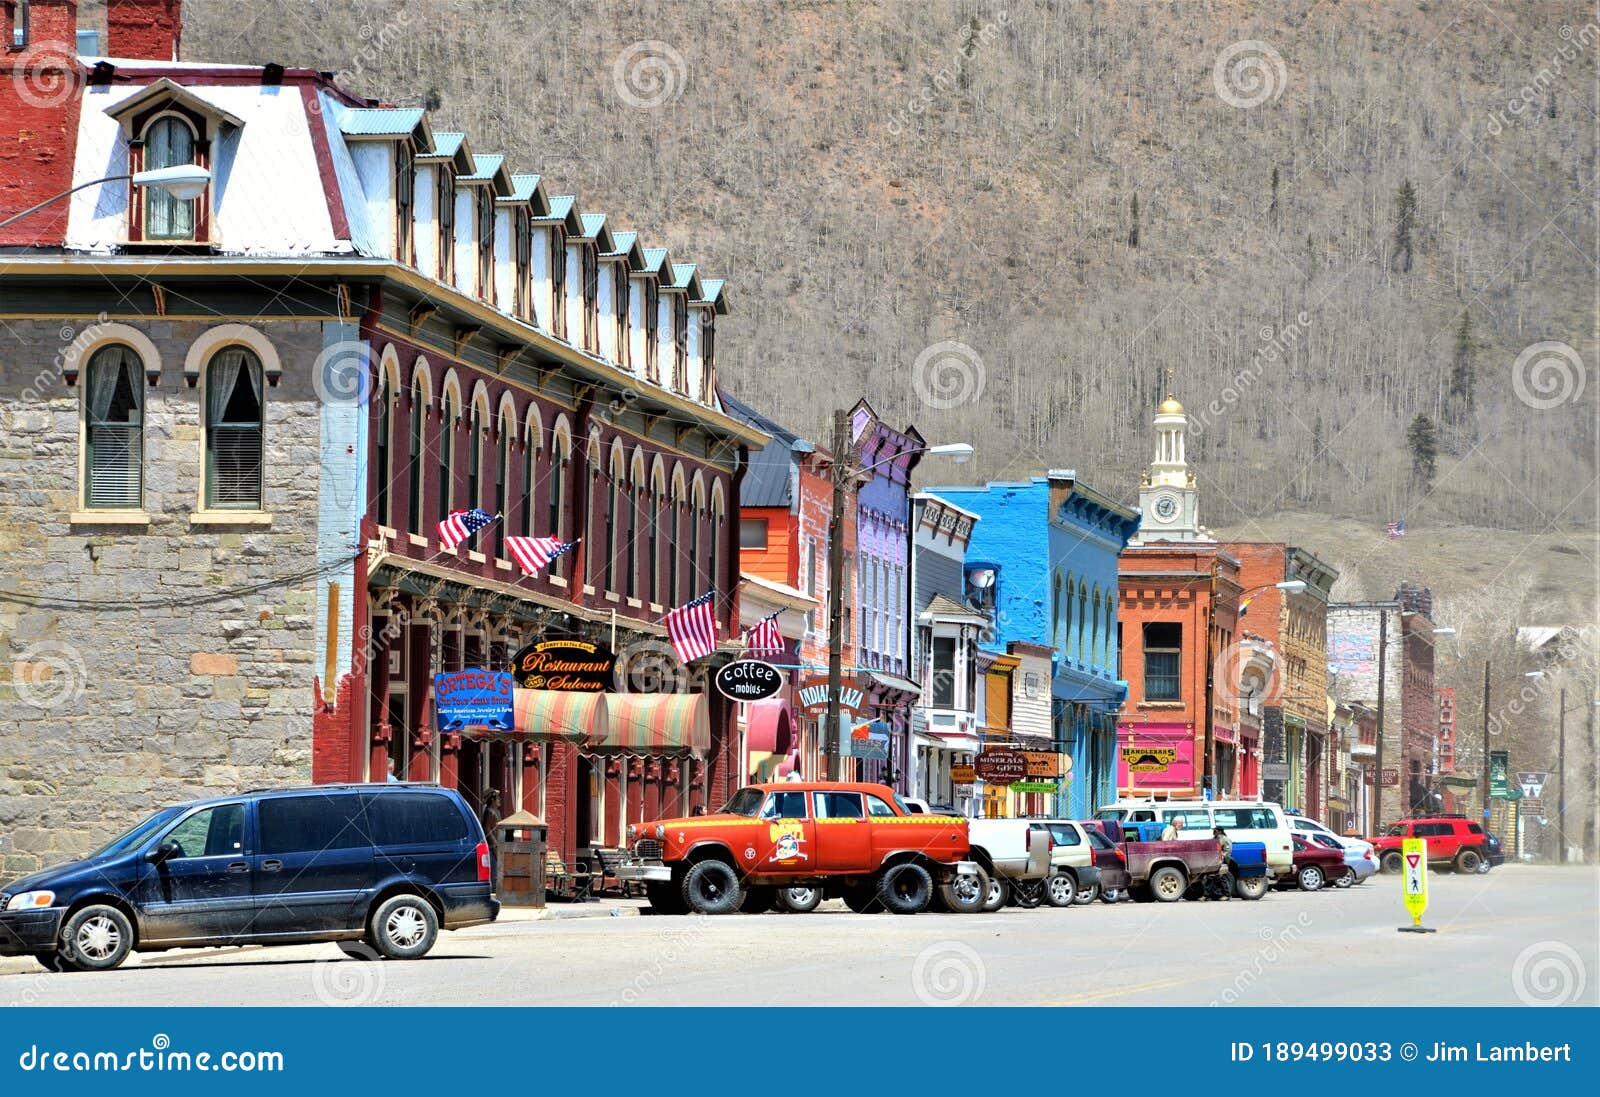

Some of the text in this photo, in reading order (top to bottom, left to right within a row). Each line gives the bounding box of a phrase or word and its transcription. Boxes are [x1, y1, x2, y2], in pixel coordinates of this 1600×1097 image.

[522, 652, 610, 672] Restaurant
[724, 663, 774, 681] coffee
[437, 673, 511, 696] ORTEGA'S
[546, 674, 603, 690] Saloon
[839, 686, 864, 709] LAZA
[1122, 748, 1175, 756] HANDLEBARS
[997, 764, 1024, 772] GIFTS
